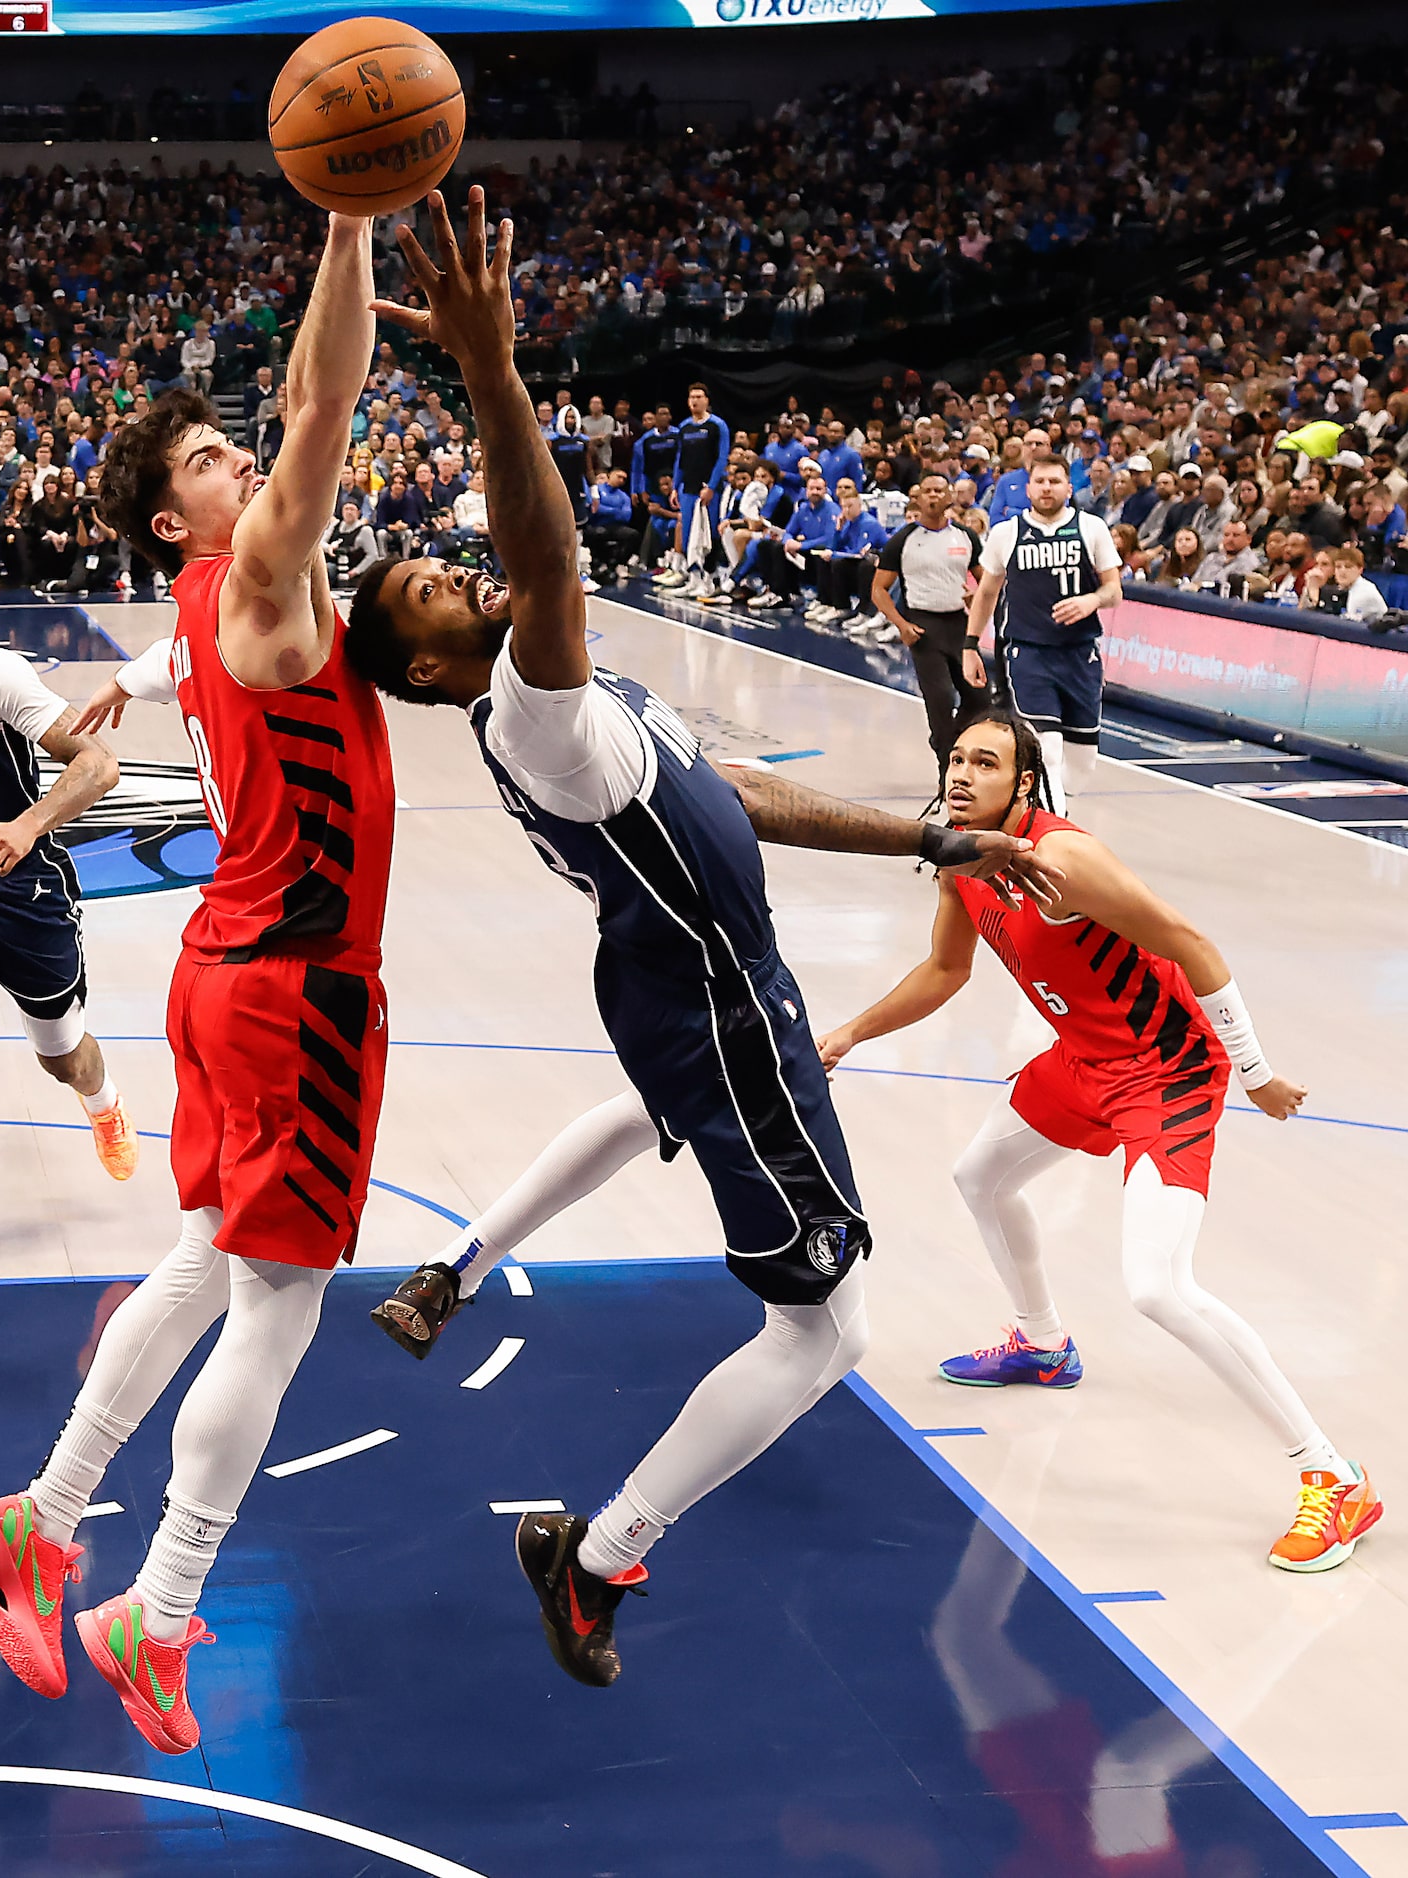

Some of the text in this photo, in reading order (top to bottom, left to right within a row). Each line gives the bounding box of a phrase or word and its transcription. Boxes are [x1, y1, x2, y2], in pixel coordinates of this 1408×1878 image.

[13, 16, 25, 31] 6
[327, 118, 452, 175] Wilson
[1017, 540, 1081, 570] MAVS
[1052, 566, 1081, 596] 77
[1163, 646, 1176, 672] to
[188, 715, 228, 838] 8
[1032, 982, 1070, 1015] 5
